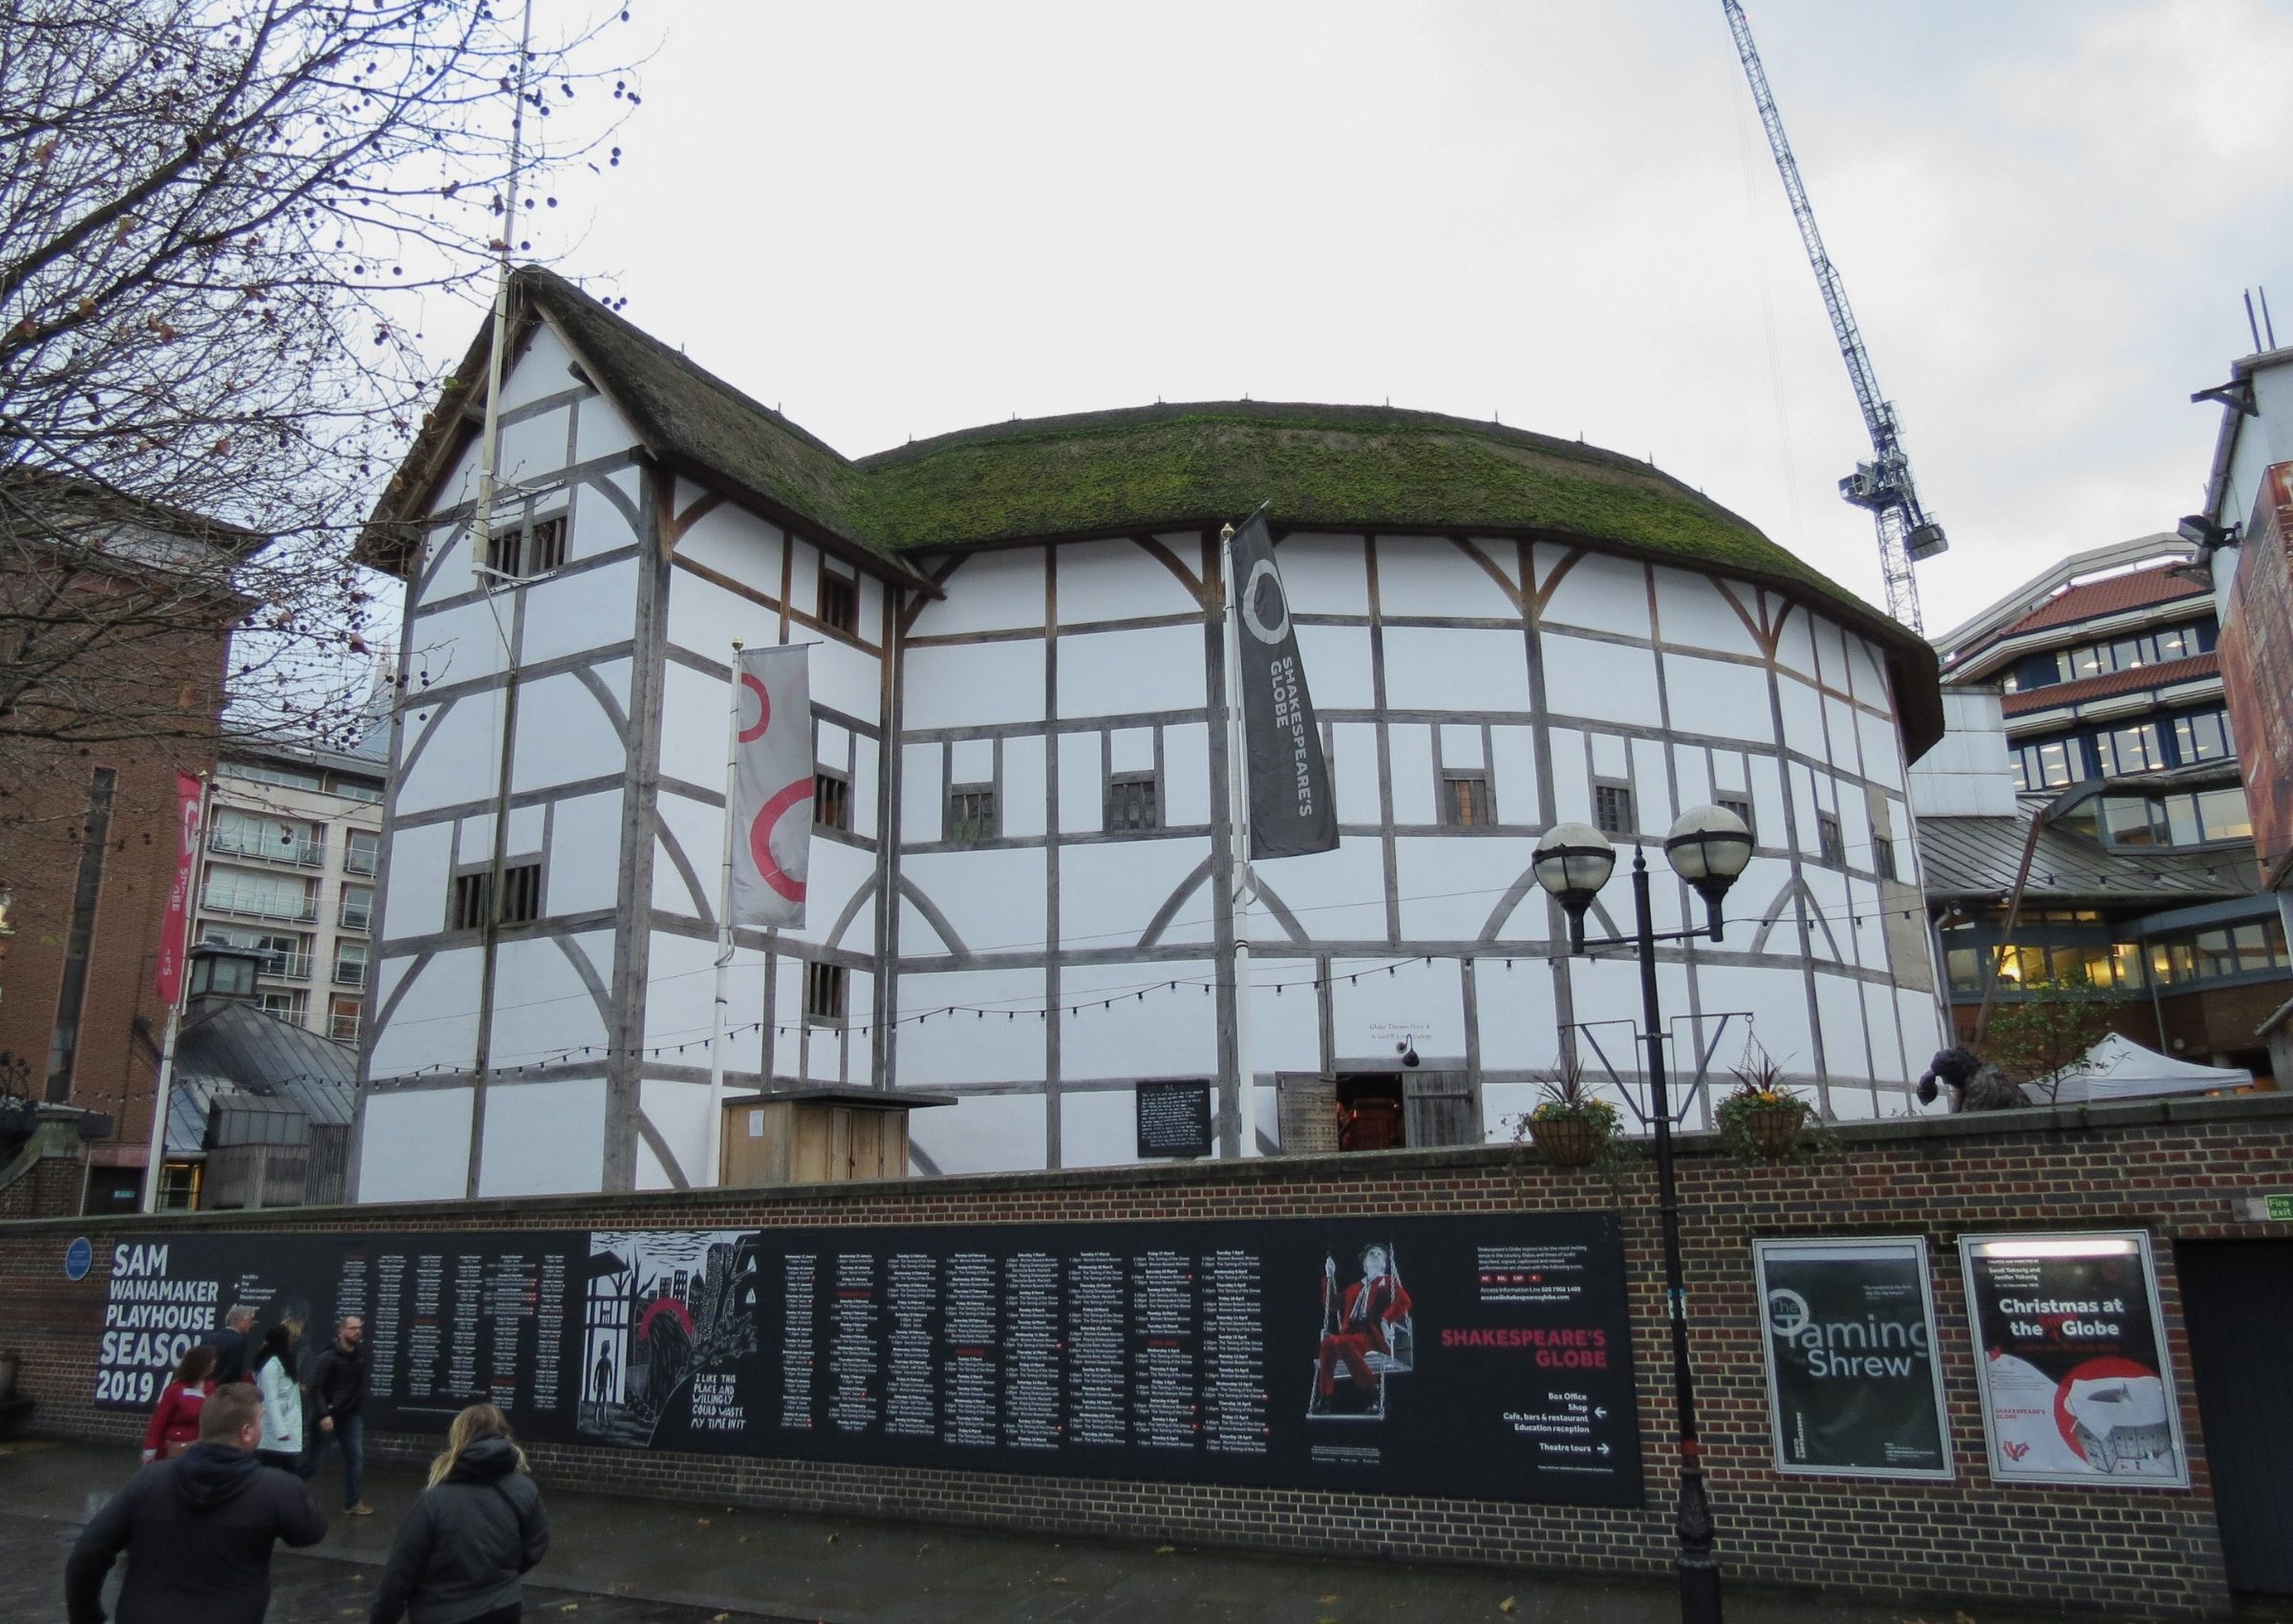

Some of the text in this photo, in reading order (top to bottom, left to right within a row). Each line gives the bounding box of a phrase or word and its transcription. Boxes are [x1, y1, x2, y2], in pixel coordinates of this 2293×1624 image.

[1271, 660, 1289, 729] GLOBE
[1283, 656, 1312, 817] SHAKESPEARE'S
[2269, 1198, 2289, 1207] Fire
[2270, 1207, 2292, 1217] exit
[113, 1244, 169, 1277] SAM
[110, 1280, 219, 1302] WANAMAKER
[1773, 1300, 1799, 1314] The
[1999, 1297, 2124, 1314] Christmas at
[106, 1304, 216, 1331] PLAYHOUSE
[2009, 1320, 2043, 1336] the
[2061, 1319, 2120, 1336] Globe
[1441, 1329, 1606, 1347] SHAKESPEARE'S
[100, 1331, 202, 1368] SEASO
[1535, 1350, 1607, 1368] GLOBE
[1808, 1350, 1912, 1377] Shrew
[696, 1373, 737, 1383] I LIKE THIS
[96, 1370, 155, 1402] 2019
[694, 1383, 735, 1395] PLACE AND
[693, 1393, 735, 1404] WILLINGLY
[1564, 1392, 1587, 1400] Office
[693, 1404, 743, 1418] COULD WASTE
[1568, 1403, 1588, 1413] Shop
[691, 1418, 705, 1428] MY
[708, 1418, 726, 1429] TIME
[1548, 1414, 1589, 1422] restaurant
[1514, 1422, 1590, 1434] Education reception
[1539, 1442, 1592, 1452] Theatre tours
